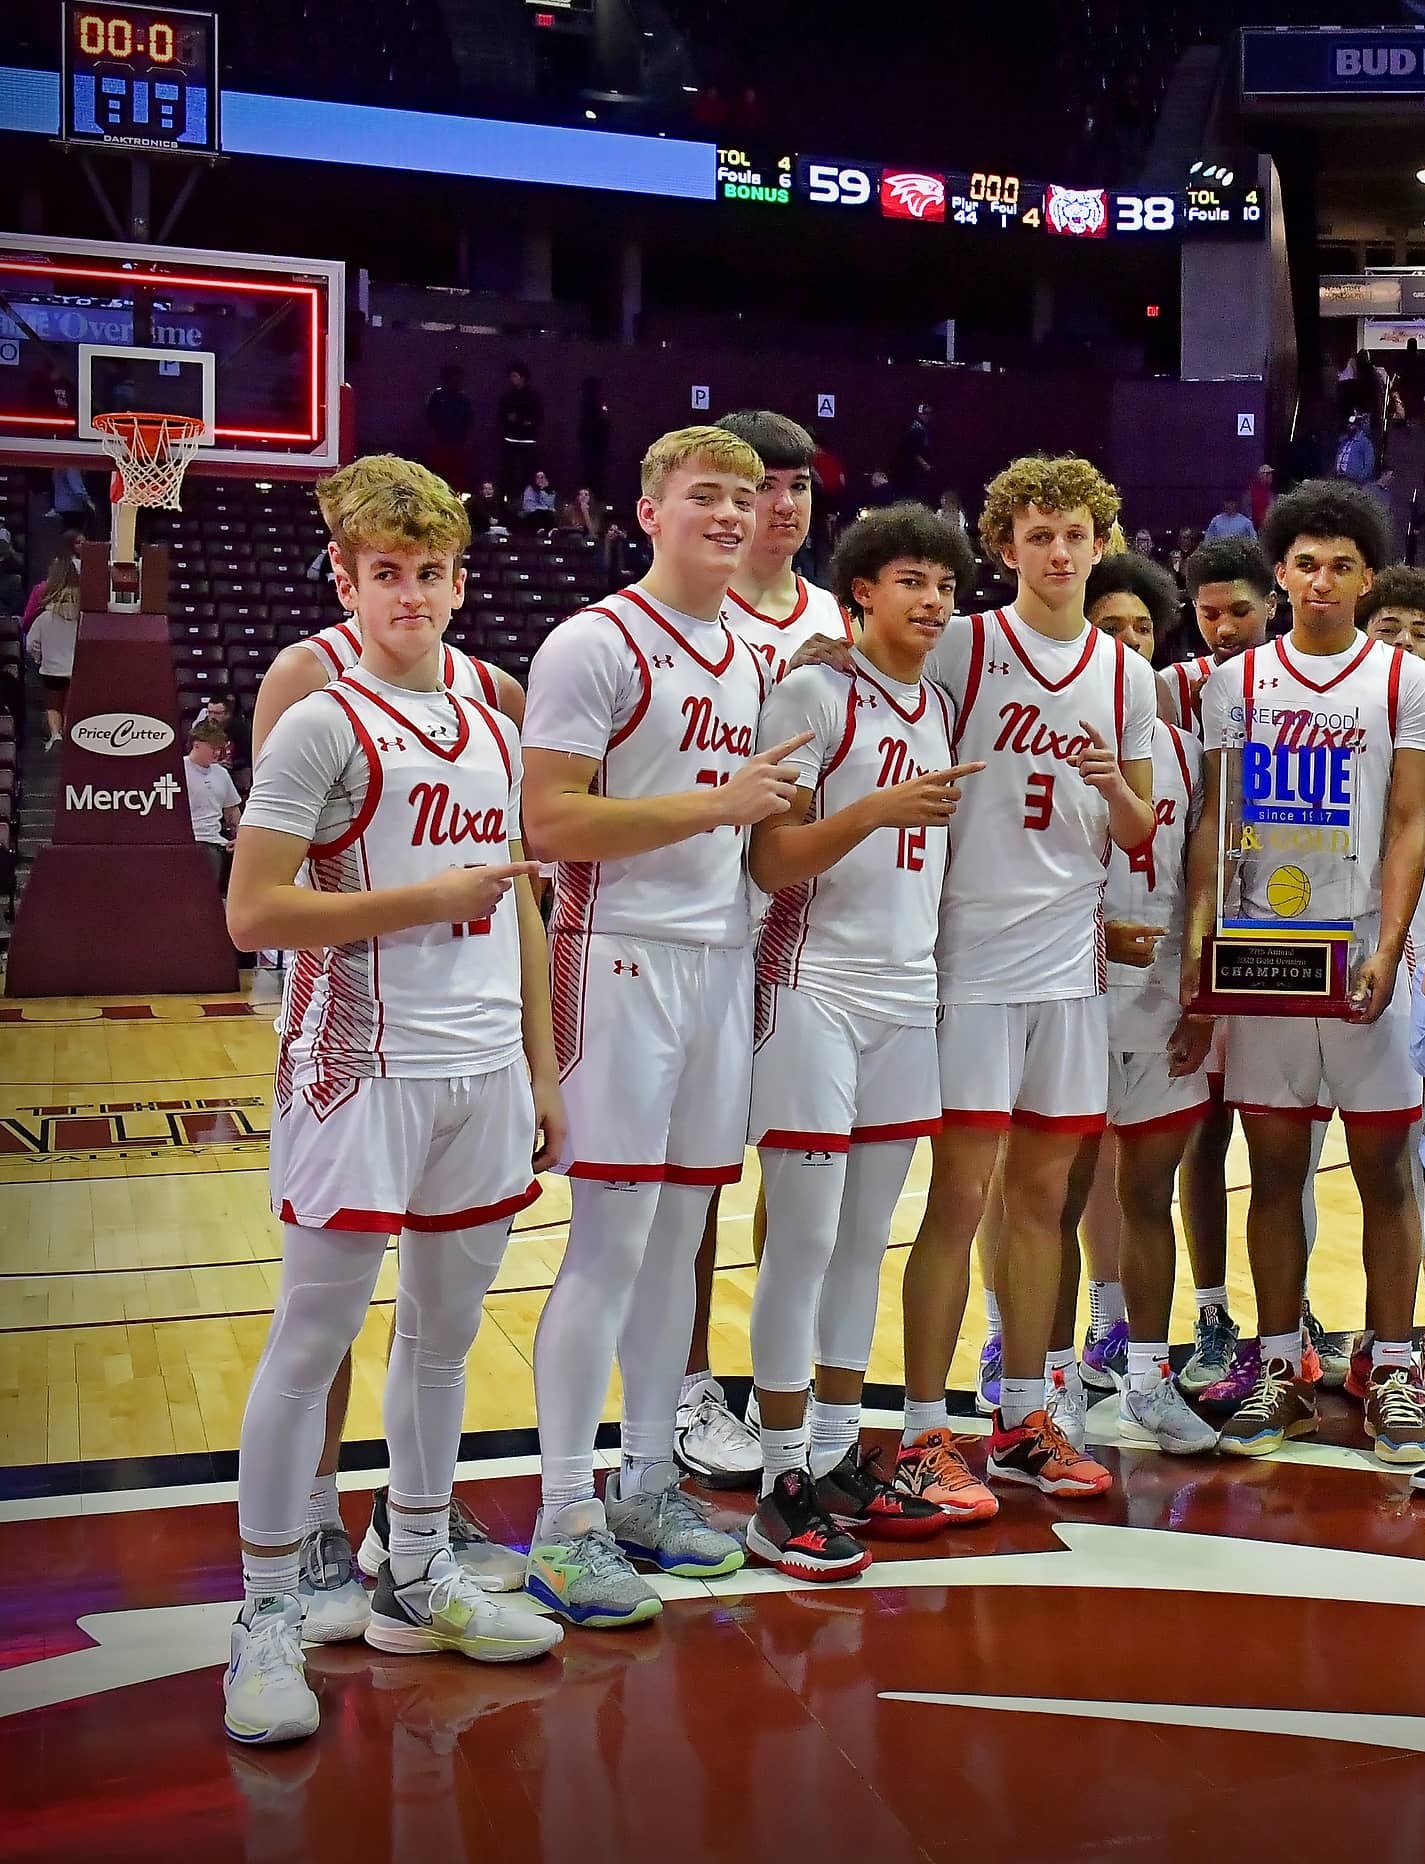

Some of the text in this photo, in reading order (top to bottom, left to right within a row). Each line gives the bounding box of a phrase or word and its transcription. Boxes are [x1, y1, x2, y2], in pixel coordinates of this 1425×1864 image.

[80, 15, 173, 63] 00.0
[1336, 48, 1417, 76] BUD
[103, 134, 179, 149] DAKTRONICS
[717, 150, 791, 171] TOL 4
[717, 167, 792, 188] Fouls 6
[809, 165, 871, 205] 59
[969, 172, 1019, 204] 00.0
[724, 183, 790, 204] BONUS
[1188, 190, 1258, 205] TOL 4
[990, 201, 1017, 215] Foul
[1022, 207, 1041, 228] 4
[1116, 196, 1175, 231] 38
[1188, 206, 1260, 221] Fouls 10
[695, 389, 706, 406] P
[819, 398, 834, 414] A
[1240, 417, 1252, 432] A
[680, 695, 752, 758] Nixa
[1243, 741, 1351, 805] BLUE
[65, 785, 158, 816] Mercy
[1023, 773, 1056, 831] 3
[408, 782, 507, 846] Nixa
[1258, 808, 1294, 822] since
[896, 826, 927, 872] 12
[1241, 825, 1350, 853] & GOLD
[1220, 966, 1323, 979] CHAMPIONS
[16, 1096, 265, 1117] THE
